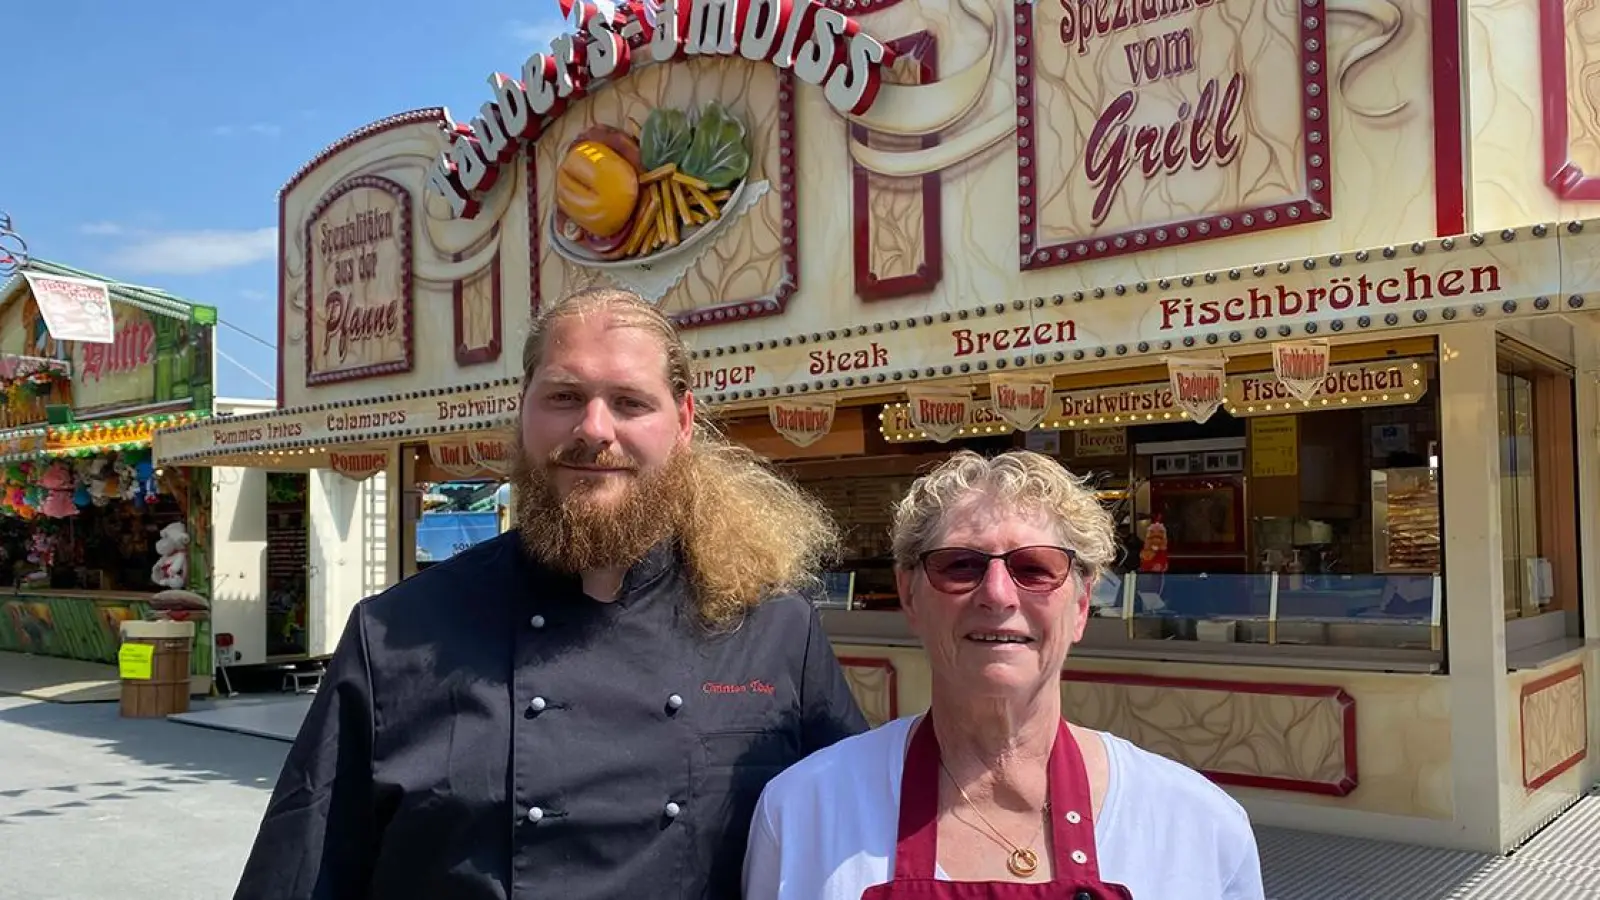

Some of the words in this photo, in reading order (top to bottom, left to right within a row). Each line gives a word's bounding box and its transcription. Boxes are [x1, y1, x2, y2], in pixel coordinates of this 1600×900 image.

[1124, 28, 1196, 85] vom
[1085, 72, 1244, 225] Grill
[321, 207, 393, 263] Spezialitäten
[335, 258, 355, 285] aus
[359, 250, 378, 280] der
[324, 290, 399, 362] Pfanne
[808, 343, 890, 375] Steak
[952, 319, 1077, 356] Brezen
[1159, 264, 1501, 330] Fischbrötchen
[1061, 391, 1173, 417] Bratwürste
[1242, 367, 1404, 402] Fiscötchen
[213, 427, 263, 446] Pommes
[267, 422, 303, 441] frites
[327, 408, 407, 431] Calamares
[437, 393, 522, 420] Bratwürs
[919, 399, 965, 425] Brezen
[1080, 430, 1124, 447] Brezen
[329, 451, 387, 472] Pommes
